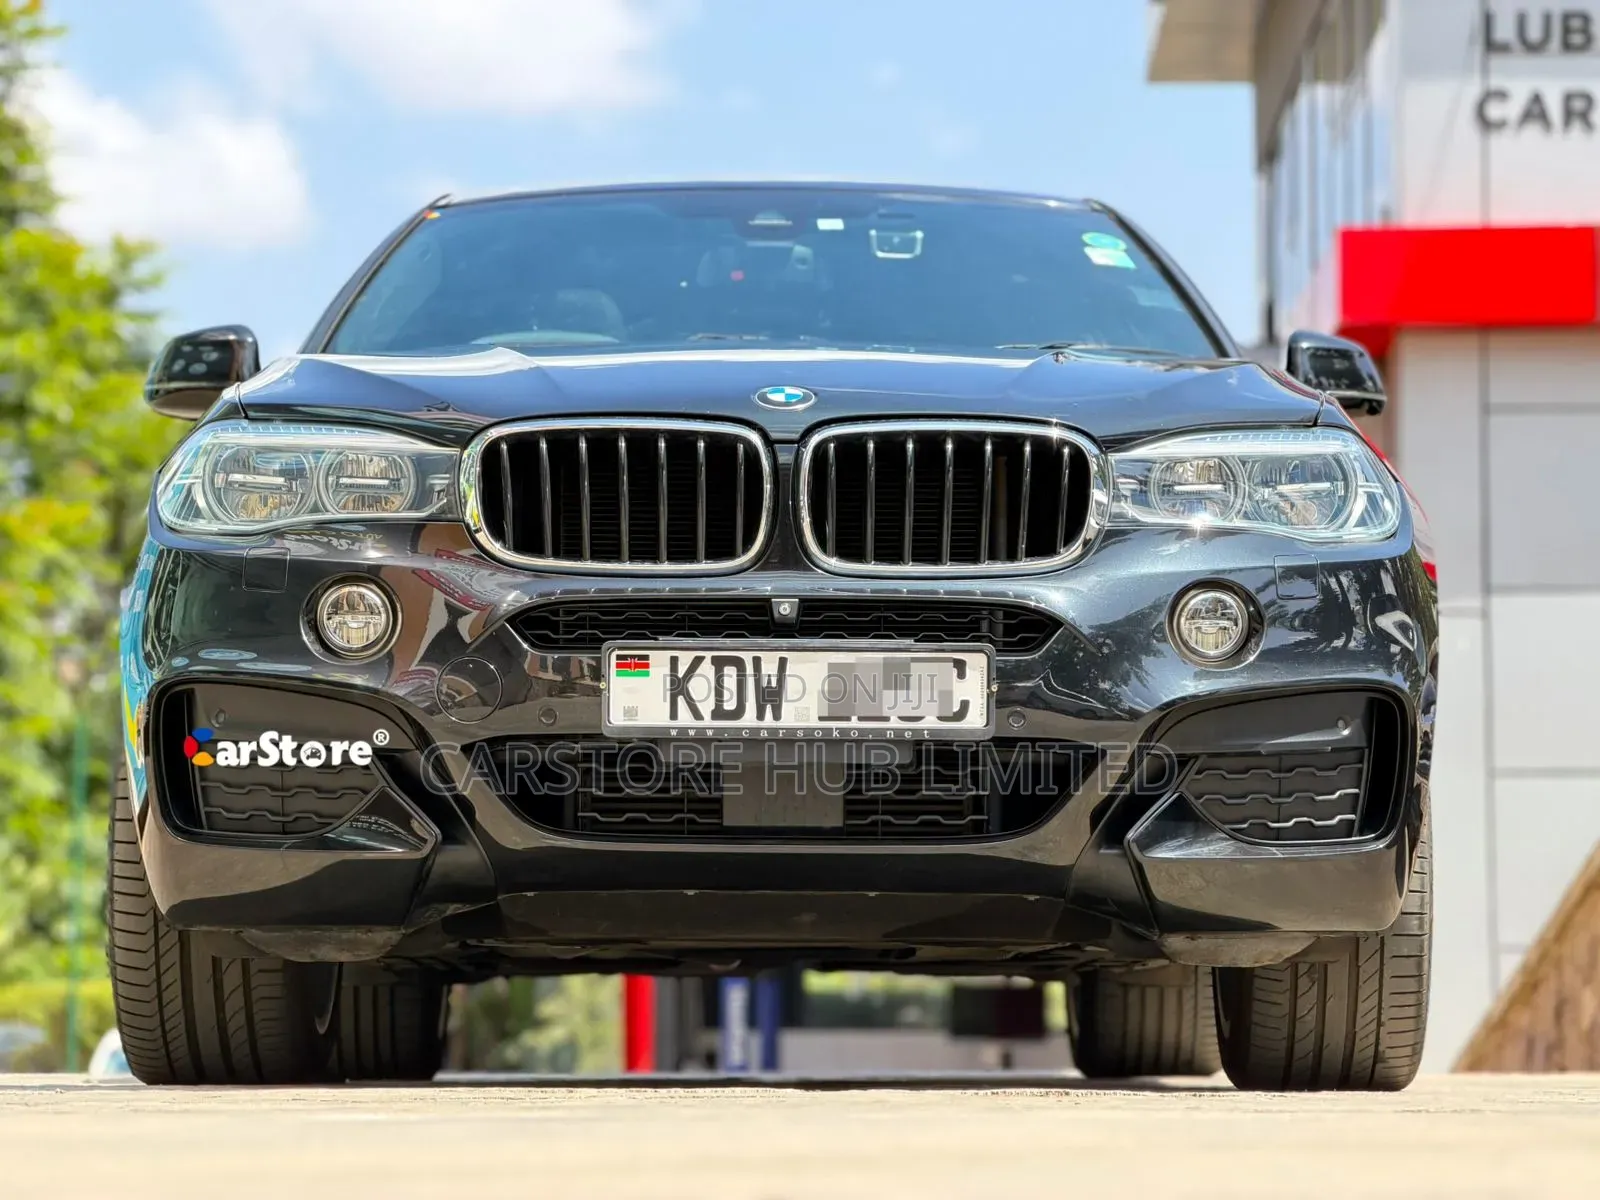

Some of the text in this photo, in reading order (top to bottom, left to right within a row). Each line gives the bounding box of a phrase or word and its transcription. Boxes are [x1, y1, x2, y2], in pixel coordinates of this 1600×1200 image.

[1483, 9, 1593, 53] LUB
[1477, 88, 1594, 133] CAR
[669, 655, 788, 721] KDW
